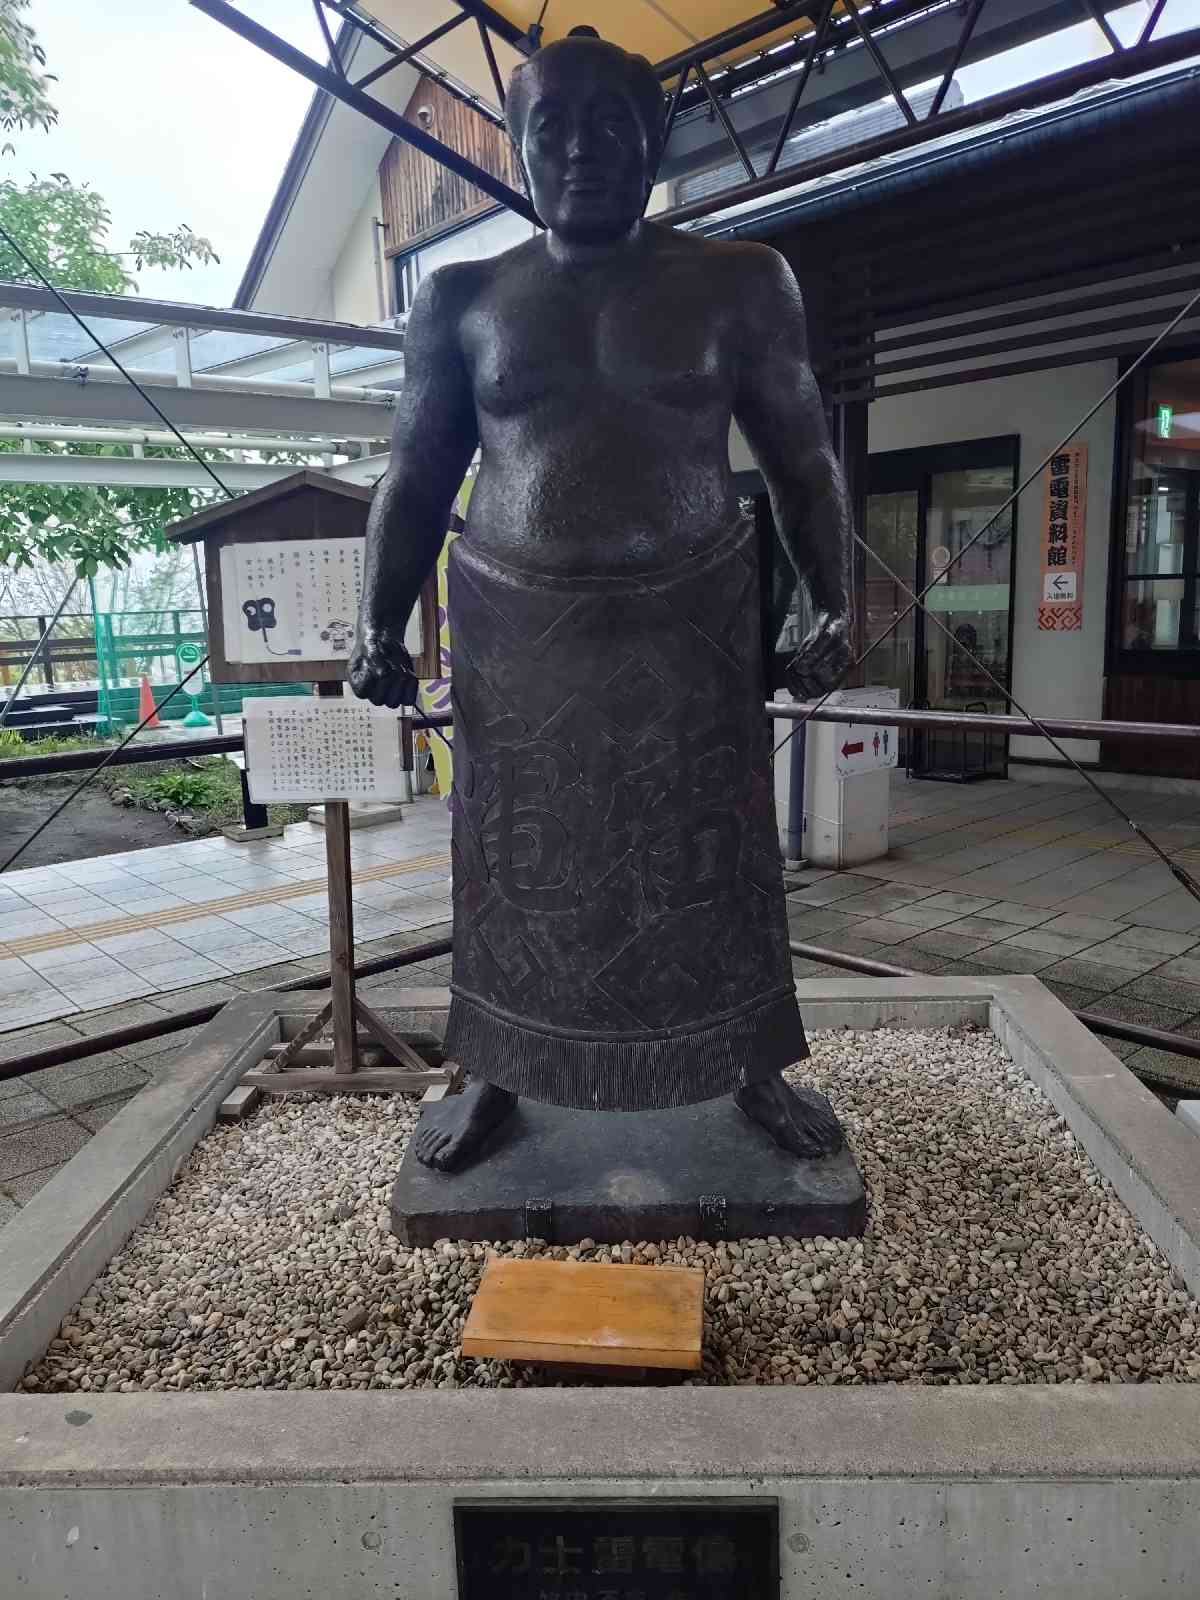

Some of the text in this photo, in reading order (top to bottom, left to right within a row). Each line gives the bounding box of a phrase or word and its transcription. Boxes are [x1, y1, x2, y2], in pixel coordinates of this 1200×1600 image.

[1048, 453, 1070, 567] 雷電資料館
